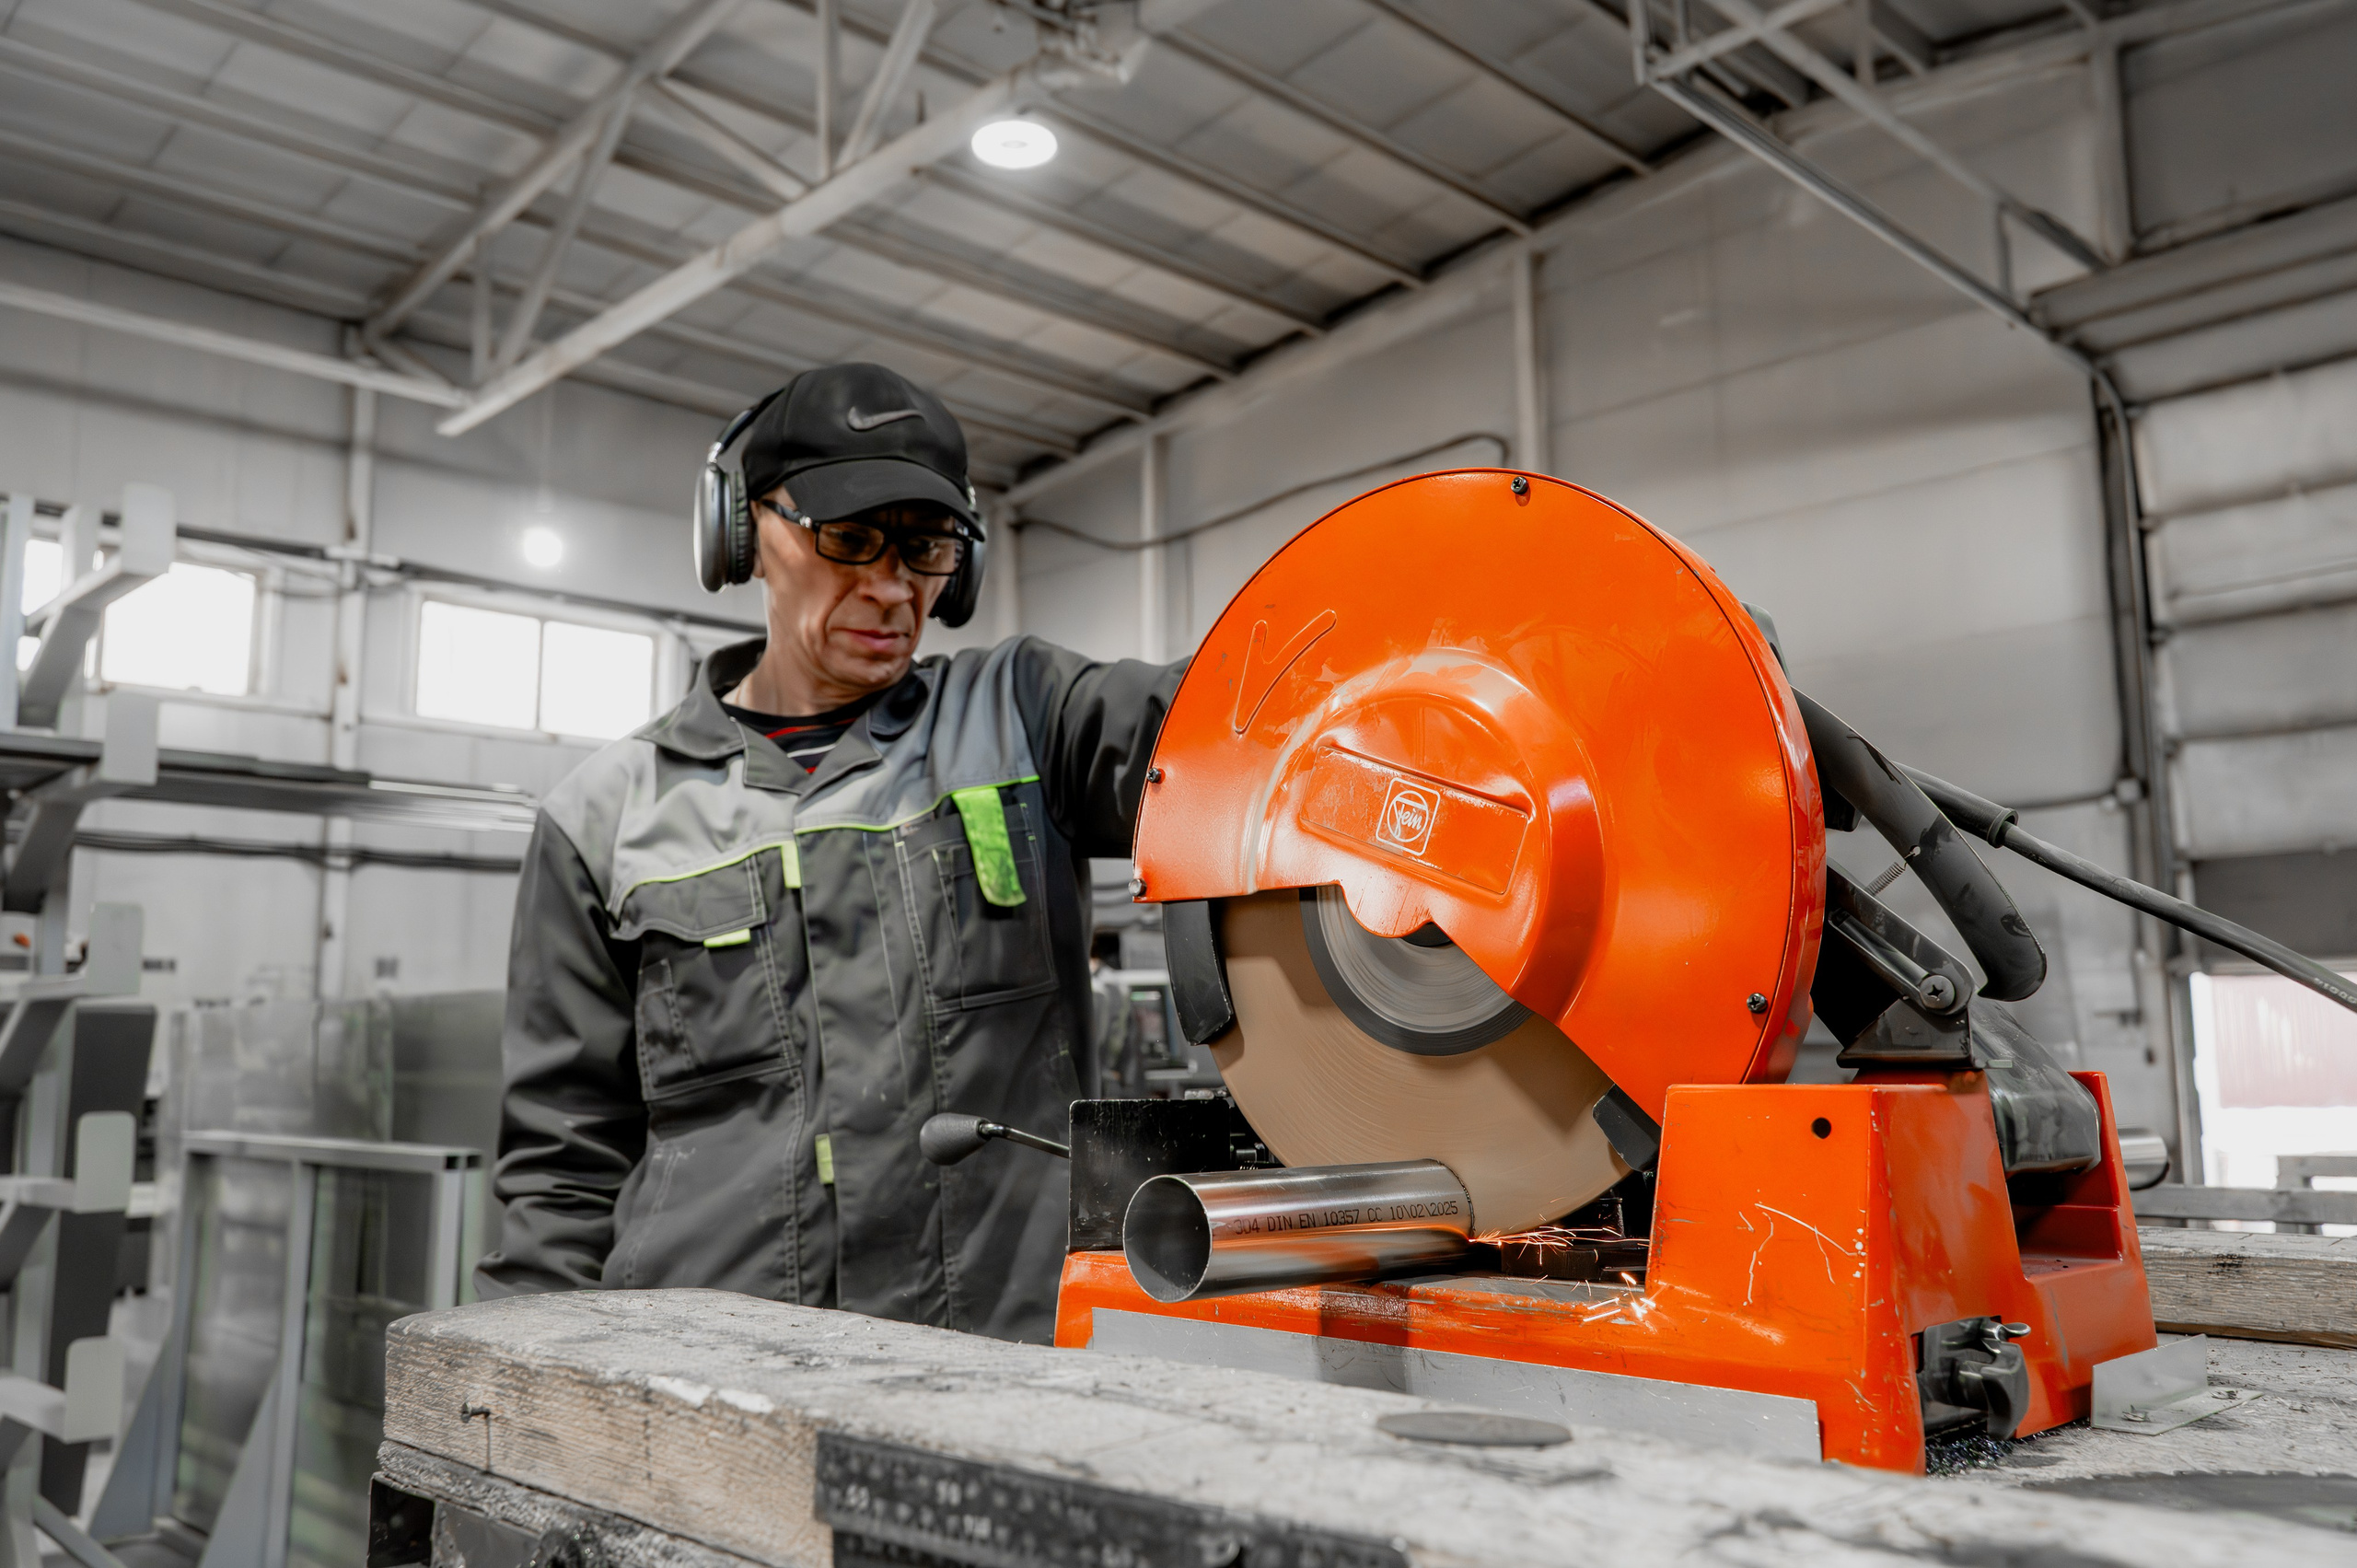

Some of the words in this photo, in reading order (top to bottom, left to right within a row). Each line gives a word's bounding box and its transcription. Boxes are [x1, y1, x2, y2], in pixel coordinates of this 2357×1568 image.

[1234, 1218, 1260, 1235] 304
[1267, 1215, 1294, 1232] DIN
[1299, 1213, 1317, 1229] EN
[1324, 1209, 1360, 1227] 10357
[1367, 1207, 1383, 1223] CC
[1390, 1201, 1458, 1221] 10\02\2025
